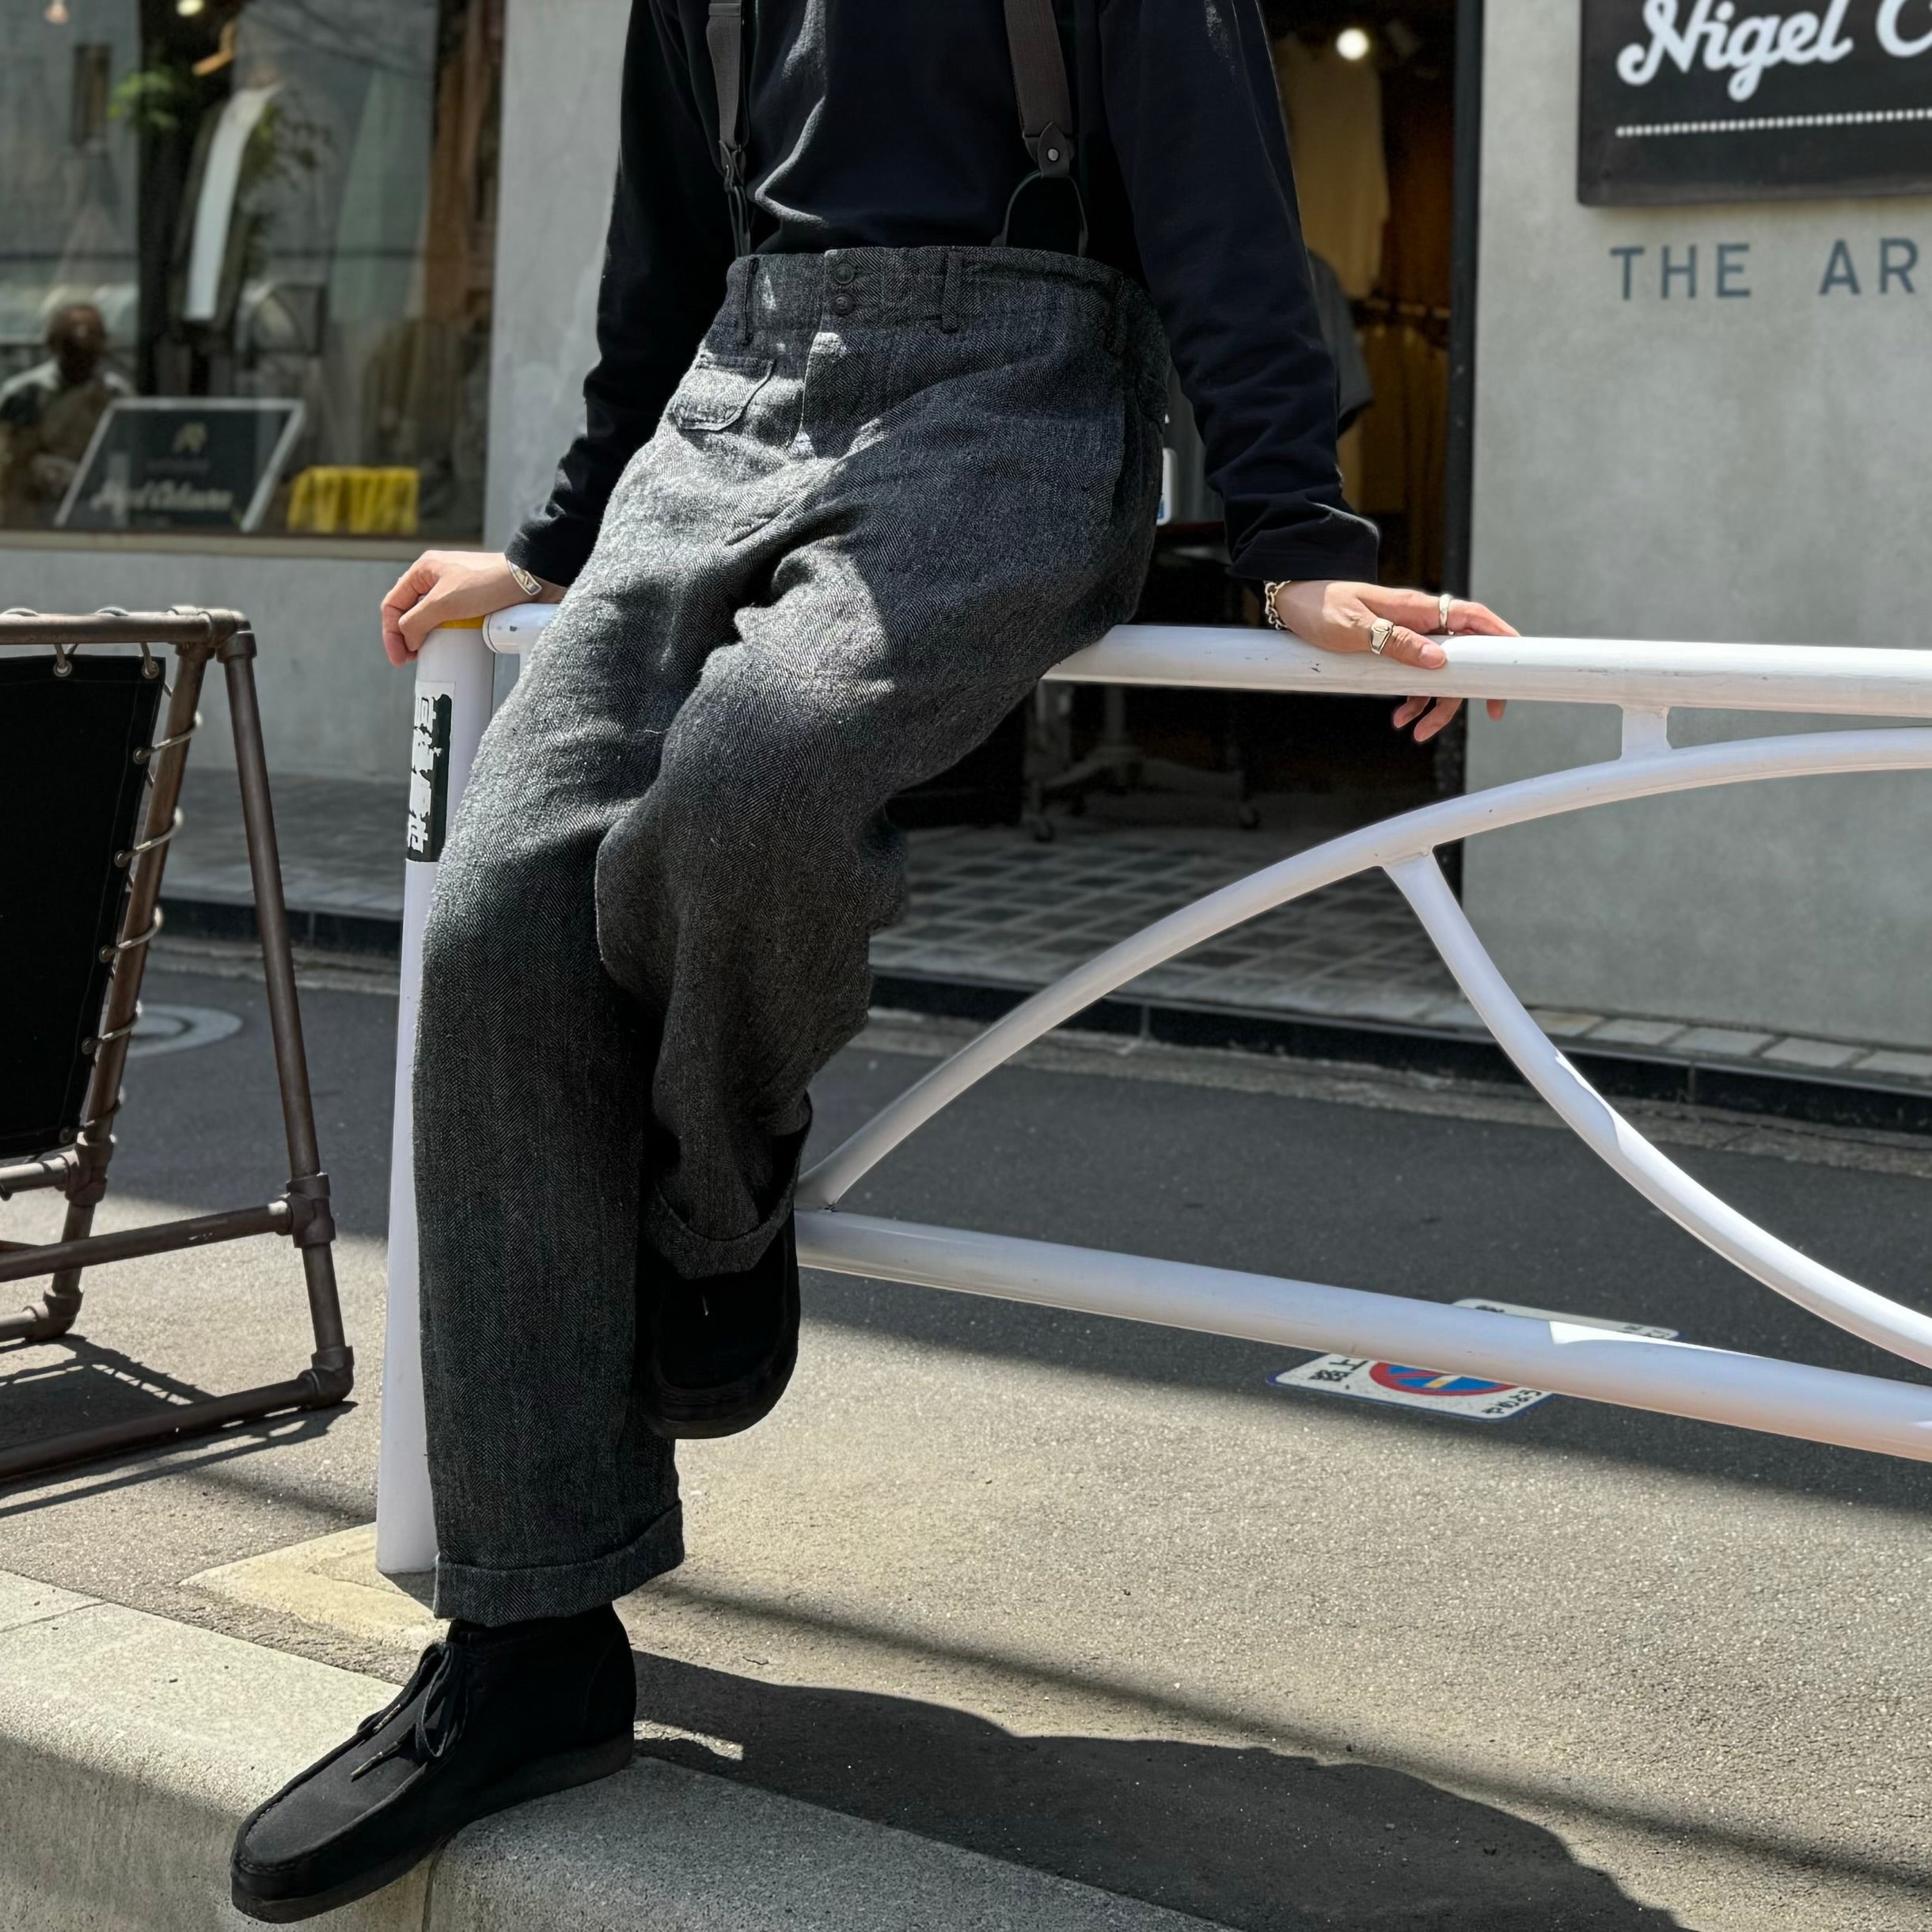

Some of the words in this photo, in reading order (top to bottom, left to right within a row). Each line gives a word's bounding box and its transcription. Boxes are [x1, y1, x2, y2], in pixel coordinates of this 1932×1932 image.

[1616, 0, 1854, 101] Nigel
[1610, 242, 1751, 302] THE
[1818, 237, 1919, 296] AR
